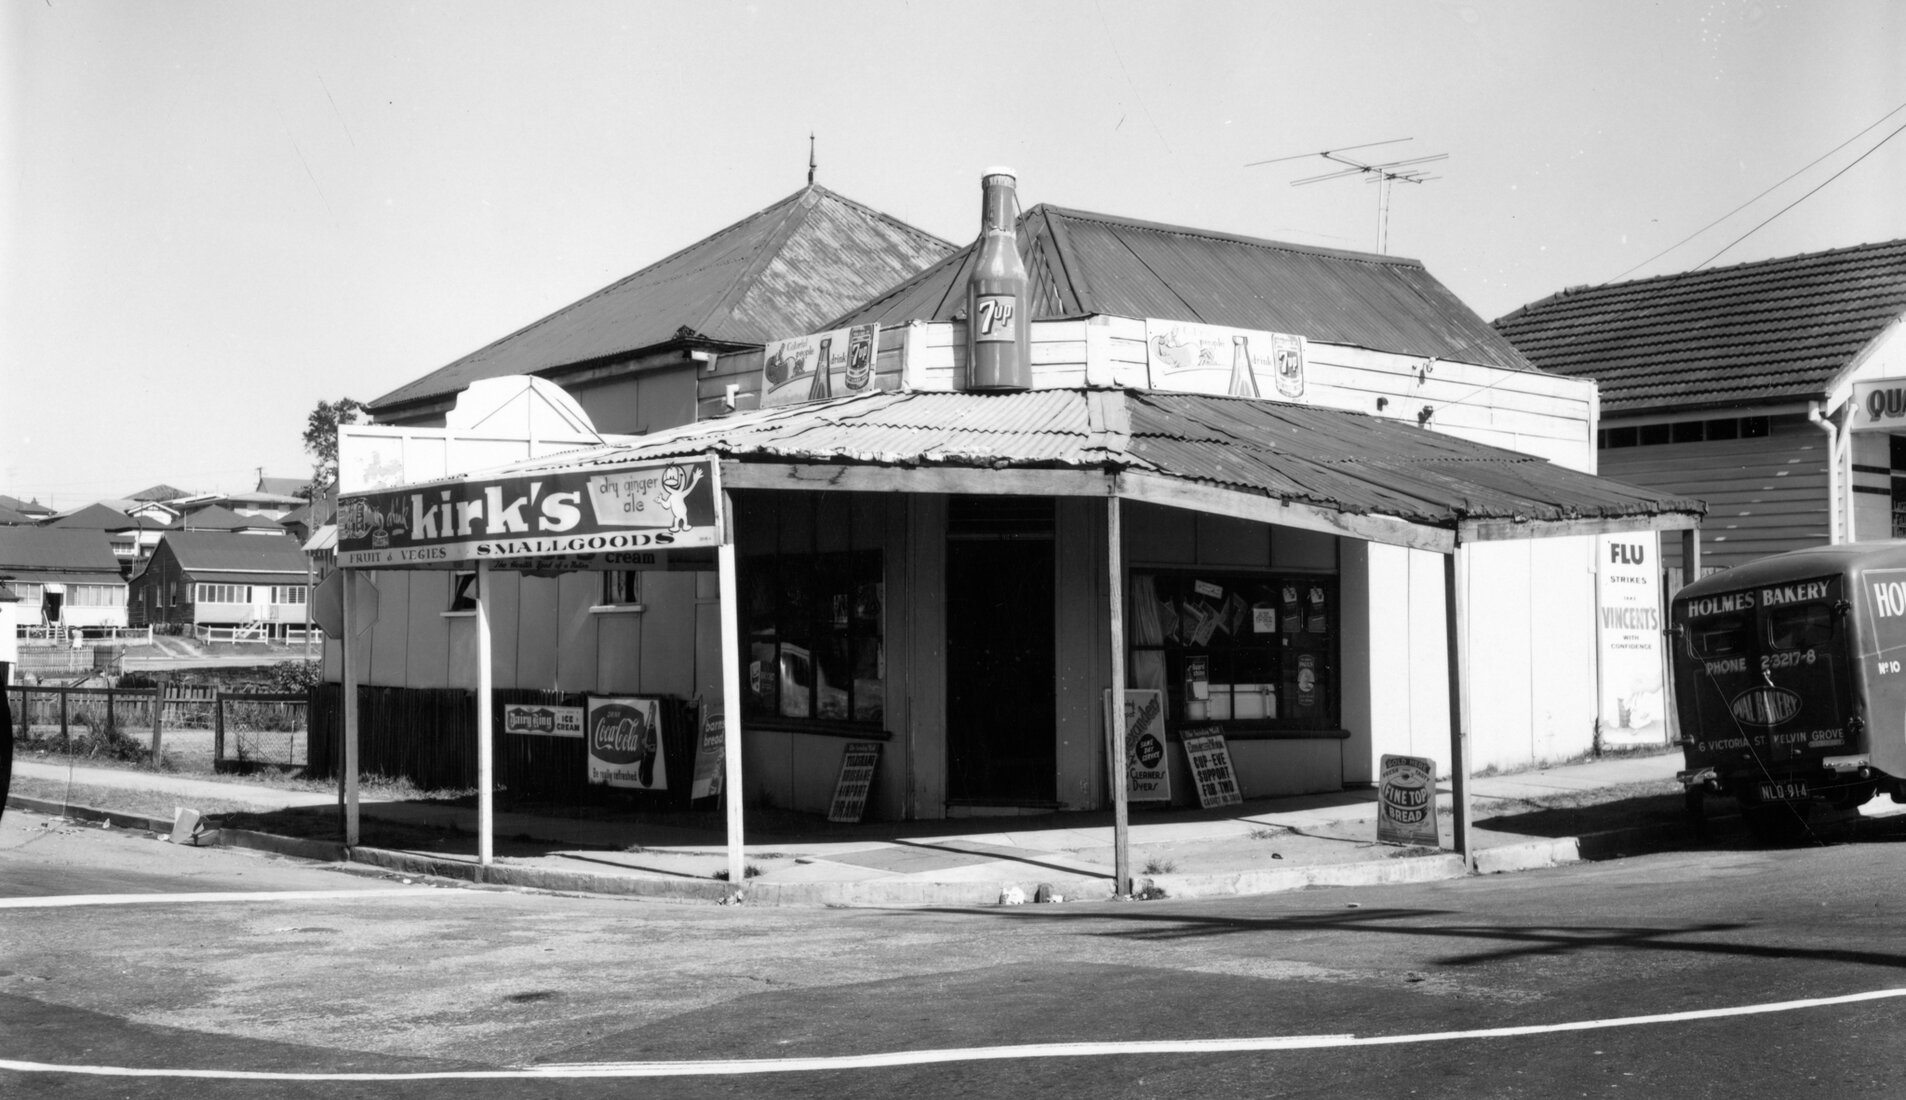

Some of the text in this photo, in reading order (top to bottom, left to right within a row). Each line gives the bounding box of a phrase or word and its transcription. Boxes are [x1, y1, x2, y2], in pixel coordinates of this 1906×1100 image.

[831, 351, 847, 365] drink
[1866, 389, 1906, 423] QU
[599, 476, 659, 499] dry ginger
[411, 481, 581, 541] kirk's
[623, 494, 645, 513] ale
[477, 532, 676, 556] SMALLGOODS
[350, 551, 382, 564] FRUIT
[400, 547, 447, 561] VEGIES
[1610, 543, 1645, 565] FLU
[1610, 575, 1647, 585] STRIKES
[1688, 580, 1831, 618] HOLMES BAKERY
[1610, 643, 1652, 651] CONFIDENCE
[1705, 657, 1747, 676] PHONE
[1889, 660, 1901, 674] 10
[556, 723, 580, 732] CREAM
[561, 715, 574, 723] ICE
[1708, 737, 1750, 750] VICTORIA
[1812, 728, 1845, 742] GROVE
[1130, 768, 1166, 780] CLEANERS
[1197, 766, 1231, 783] SUPPORT
[1202, 780, 1235, 797] FOR TWO
[1385, 785, 1427, 805] FINE TOP
[1388, 806, 1422, 823] BREAD
